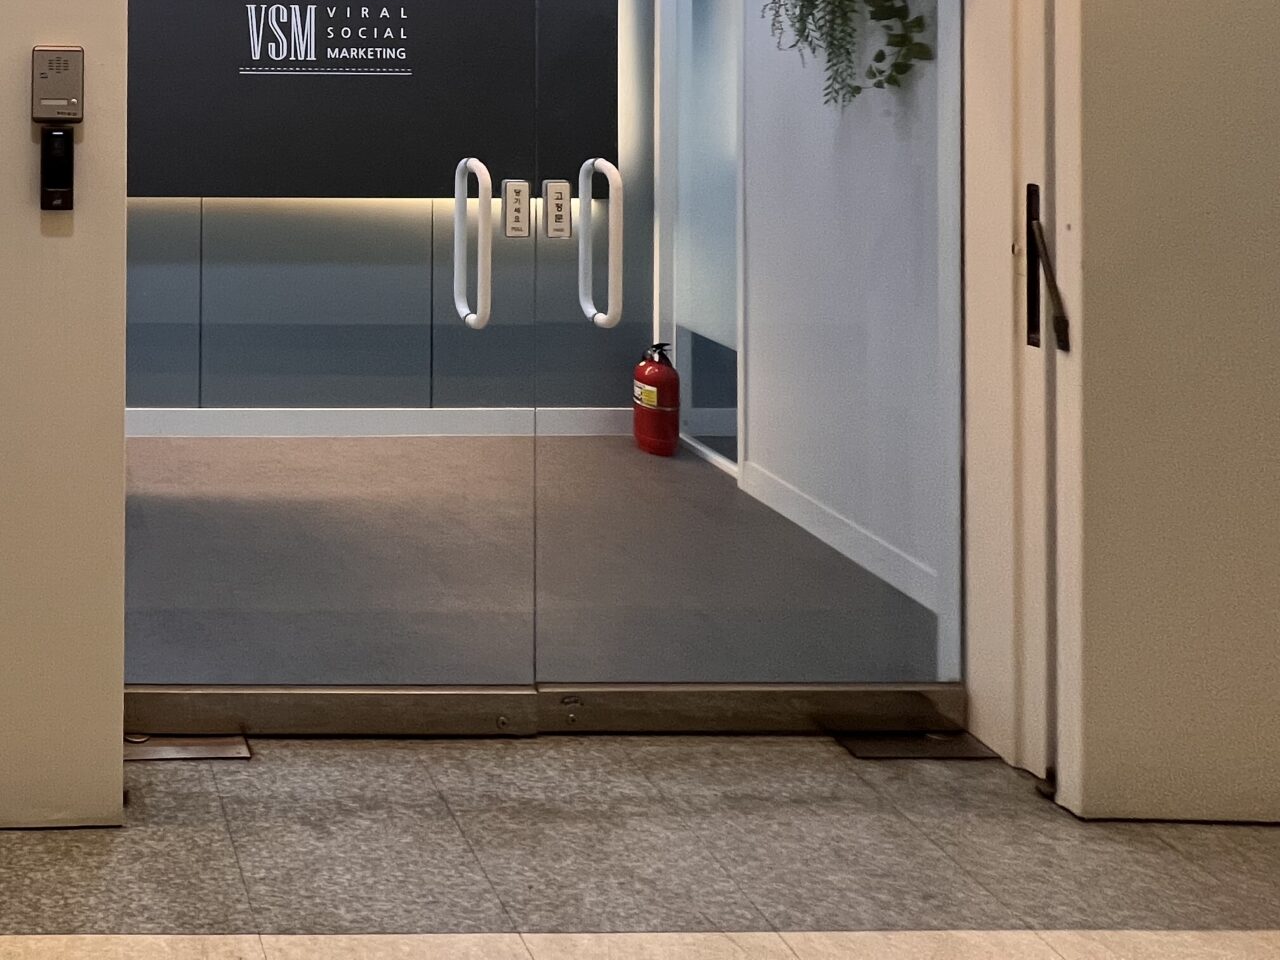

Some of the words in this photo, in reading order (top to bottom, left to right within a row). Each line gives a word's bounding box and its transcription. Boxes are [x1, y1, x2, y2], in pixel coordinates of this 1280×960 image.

[326, 6, 408, 19] VIRAL
[246, 4, 318, 61] VSM
[327, 27, 408, 39] SOCIAL
[327, 47, 407, 60] MARKETING
[554, 191, 563, 223] 고정문
